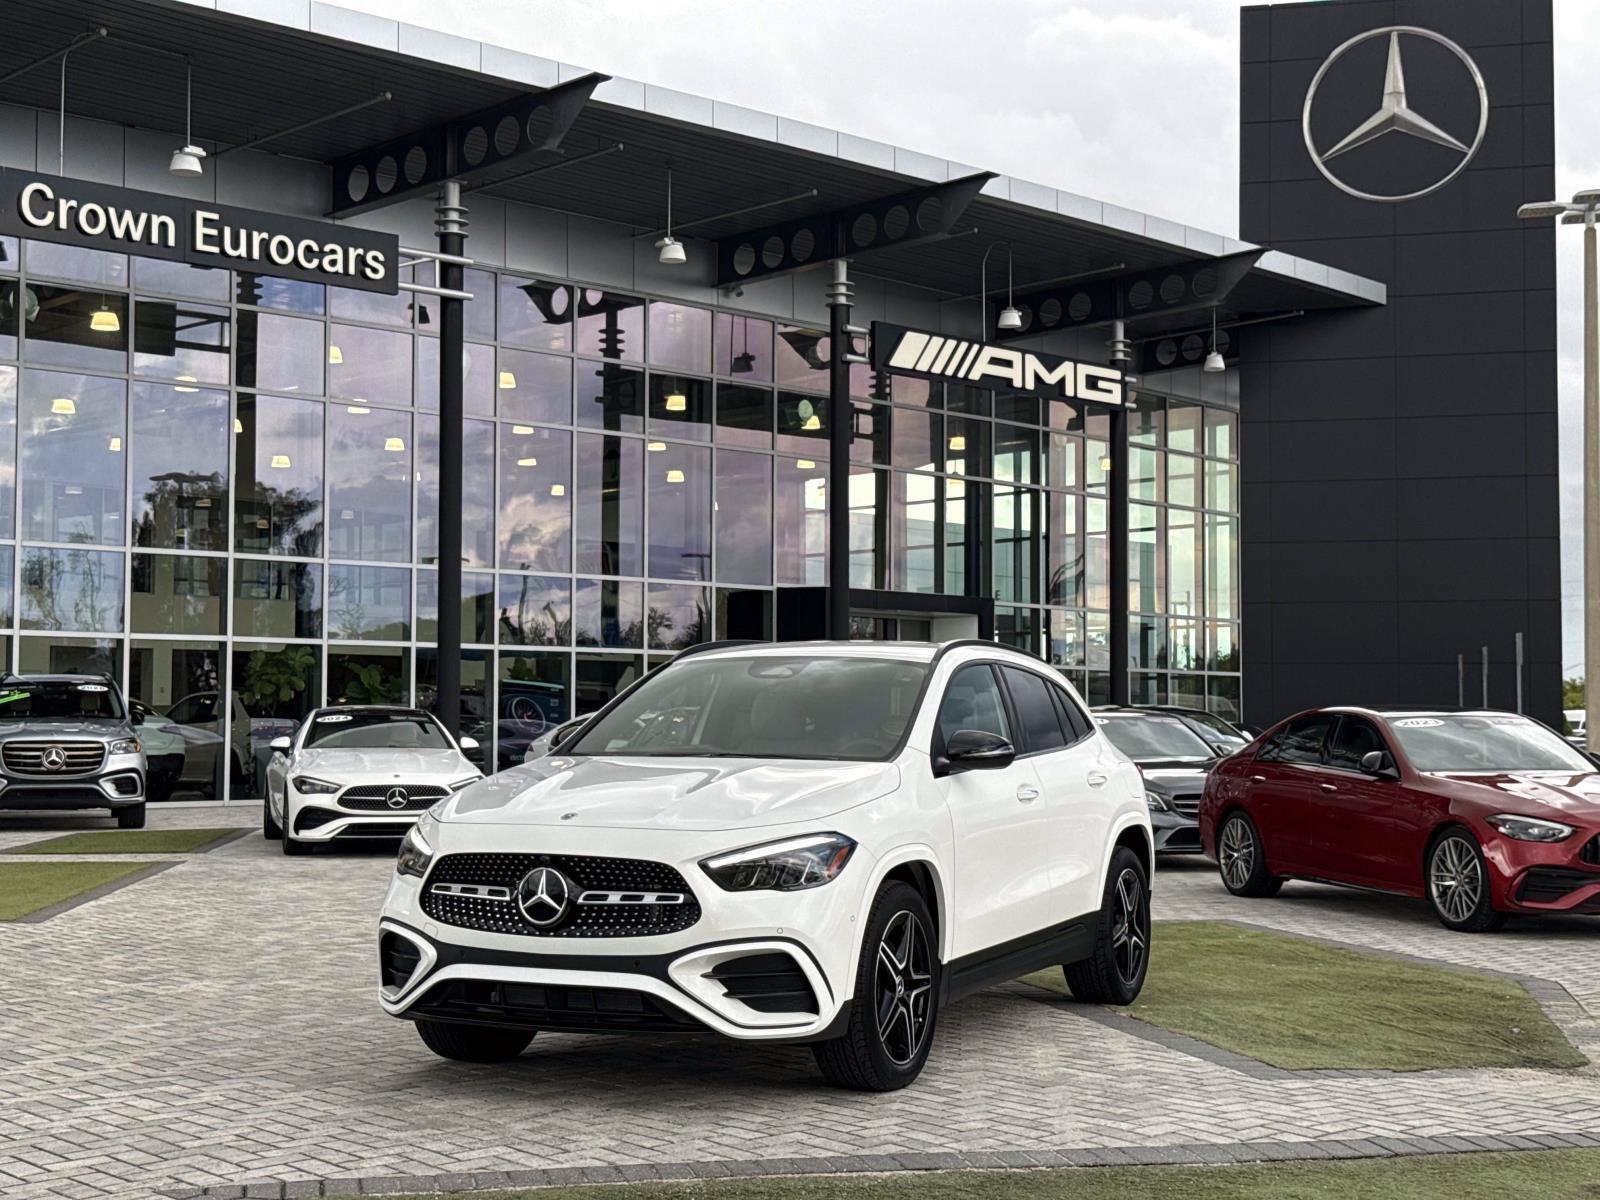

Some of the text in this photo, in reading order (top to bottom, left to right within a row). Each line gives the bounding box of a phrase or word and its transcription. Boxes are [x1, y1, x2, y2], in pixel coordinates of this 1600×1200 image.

[18, 182, 387, 281] Crown Eurocars
[967, 345, 1122, 405] AMG
